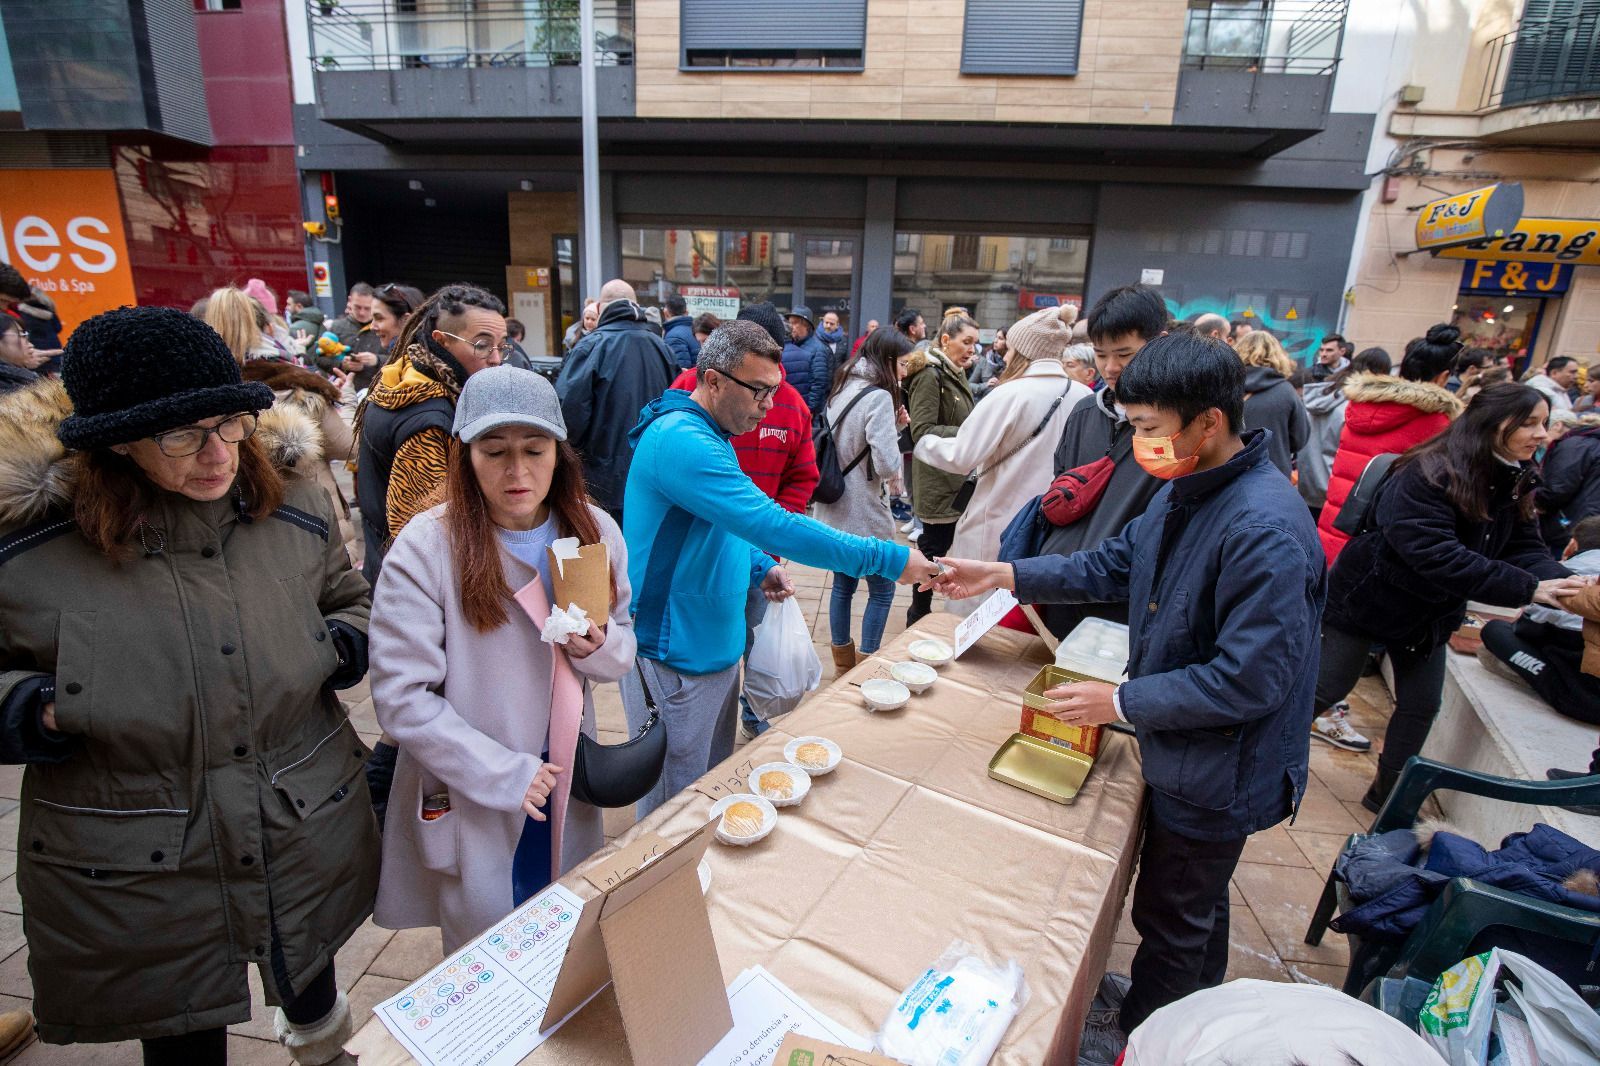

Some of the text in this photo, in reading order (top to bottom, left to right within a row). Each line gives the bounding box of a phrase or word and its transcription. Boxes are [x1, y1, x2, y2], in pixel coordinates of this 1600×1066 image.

[1426, 194, 1480, 224] F&J
[60, 279, 70, 292] &
[71, 279, 96, 295] Spa
[1470, 260, 1562, 291] F & J
[1509, 650, 1547, 675] NIKE
[749, 1019, 782, 1050] denúncia
